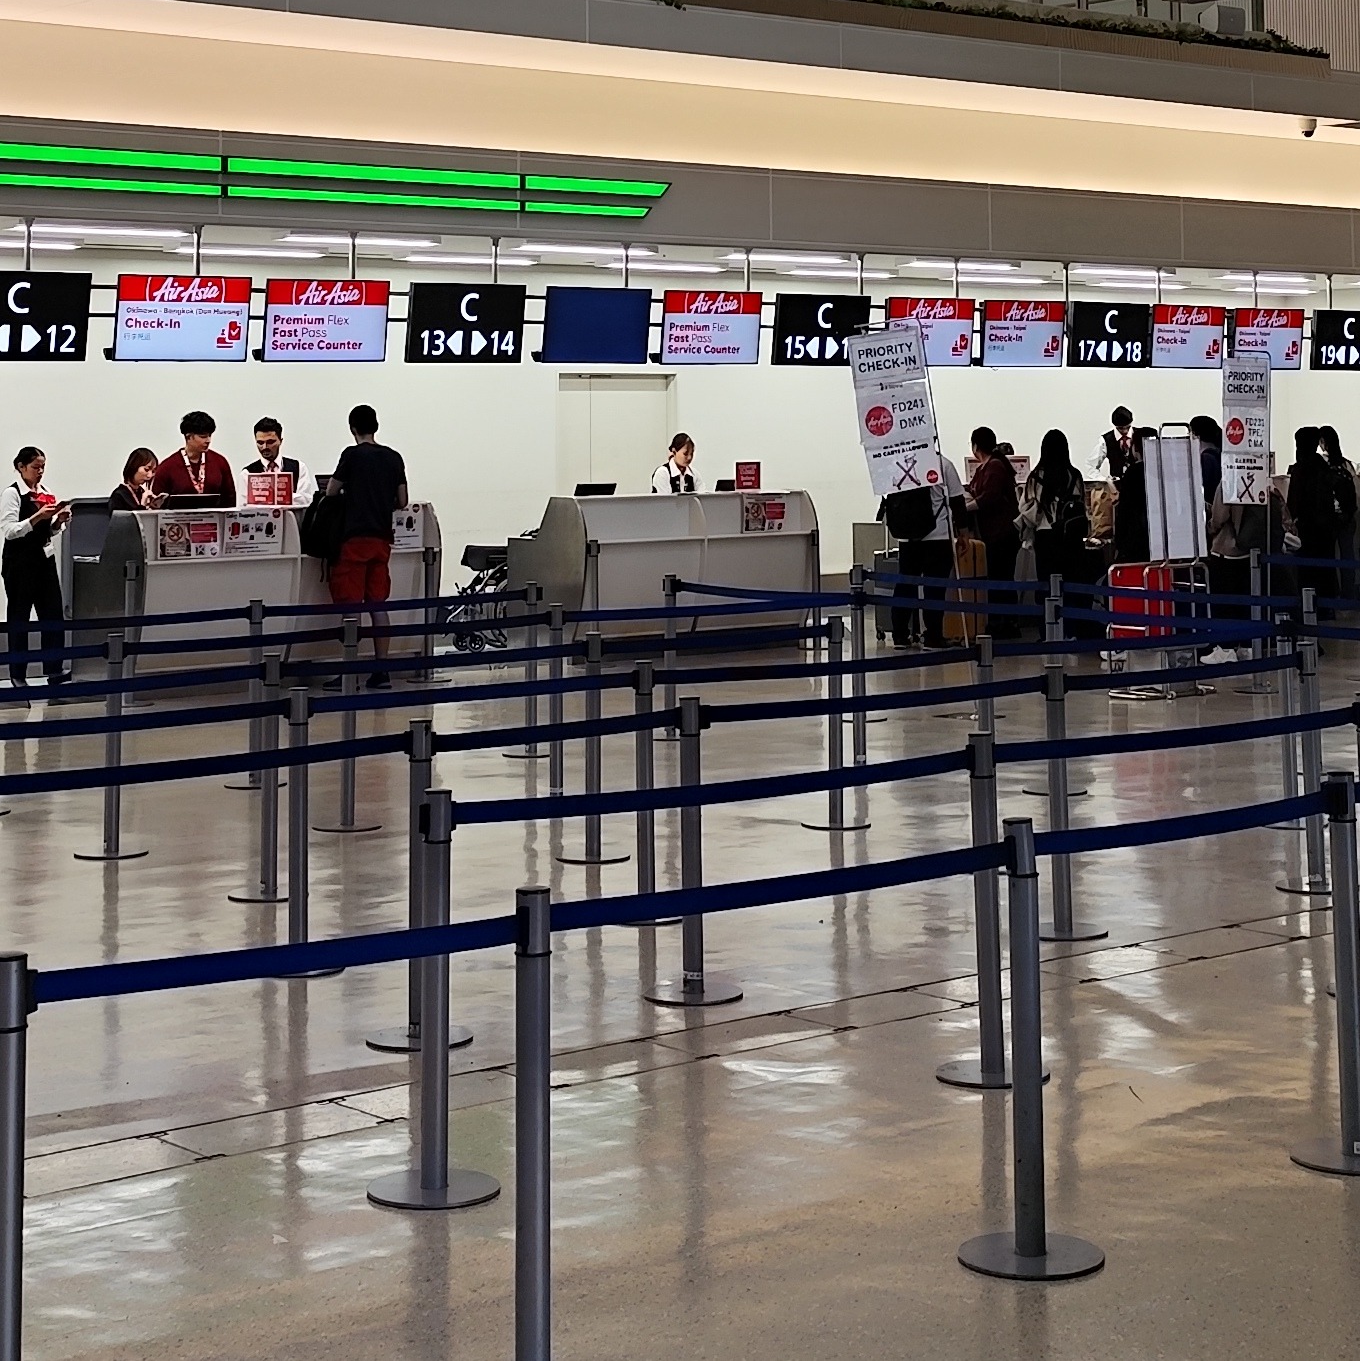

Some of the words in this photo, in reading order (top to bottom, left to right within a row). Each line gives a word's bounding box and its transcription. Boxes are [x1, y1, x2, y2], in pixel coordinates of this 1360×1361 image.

[7, 281, 32, 315] C
[153, 277, 220, 303] AirAsia
[299, 281, 361, 306] AirAsia
[460, 292, 481, 322] C
[816, 302, 834, 330] C
[125, 317, 181, 329] Check-In
[273, 314, 325, 325] Premium
[327, 314, 350, 326] Flex
[669, 321, 710, 332] Premium
[712, 322, 729, 332] Flex
[1104, 309, 1119, 334] C
[1343, 317, 1355, 339] C
[46, 324, 77, 354] 12
[272, 327, 299, 338] Fast
[301, 327, 327, 338] Pass
[668, 334, 689, 343] Fast
[691, 333, 712, 343] Pass
[989, 333, 1023, 343] Check-In
[271, 339, 315, 350] Service
[317, 339, 363, 350] Counter
[419, 329, 446, 356] 13
[488, 329, 516, 356] 14
[667, 344, 702, 354] Service
[704, 344, 741, 355] Counter
[784, 335, 807, 360] 15
[857, 342, 914, 360] PRIORITY
[1078, 340, 1095, 361] 17
[1125, 341, 1142, 362] 18
[1320, 345, 1336, 365] 19
[858, 355, 917, 374] CHECK-IN
[1227, 371, 1265, 382] PRIORITY
[1227, 383, 1265, 395] CHECK-IN
[891, 398, 926, 414] FD241
[899, 415, 927, 430] DMK
